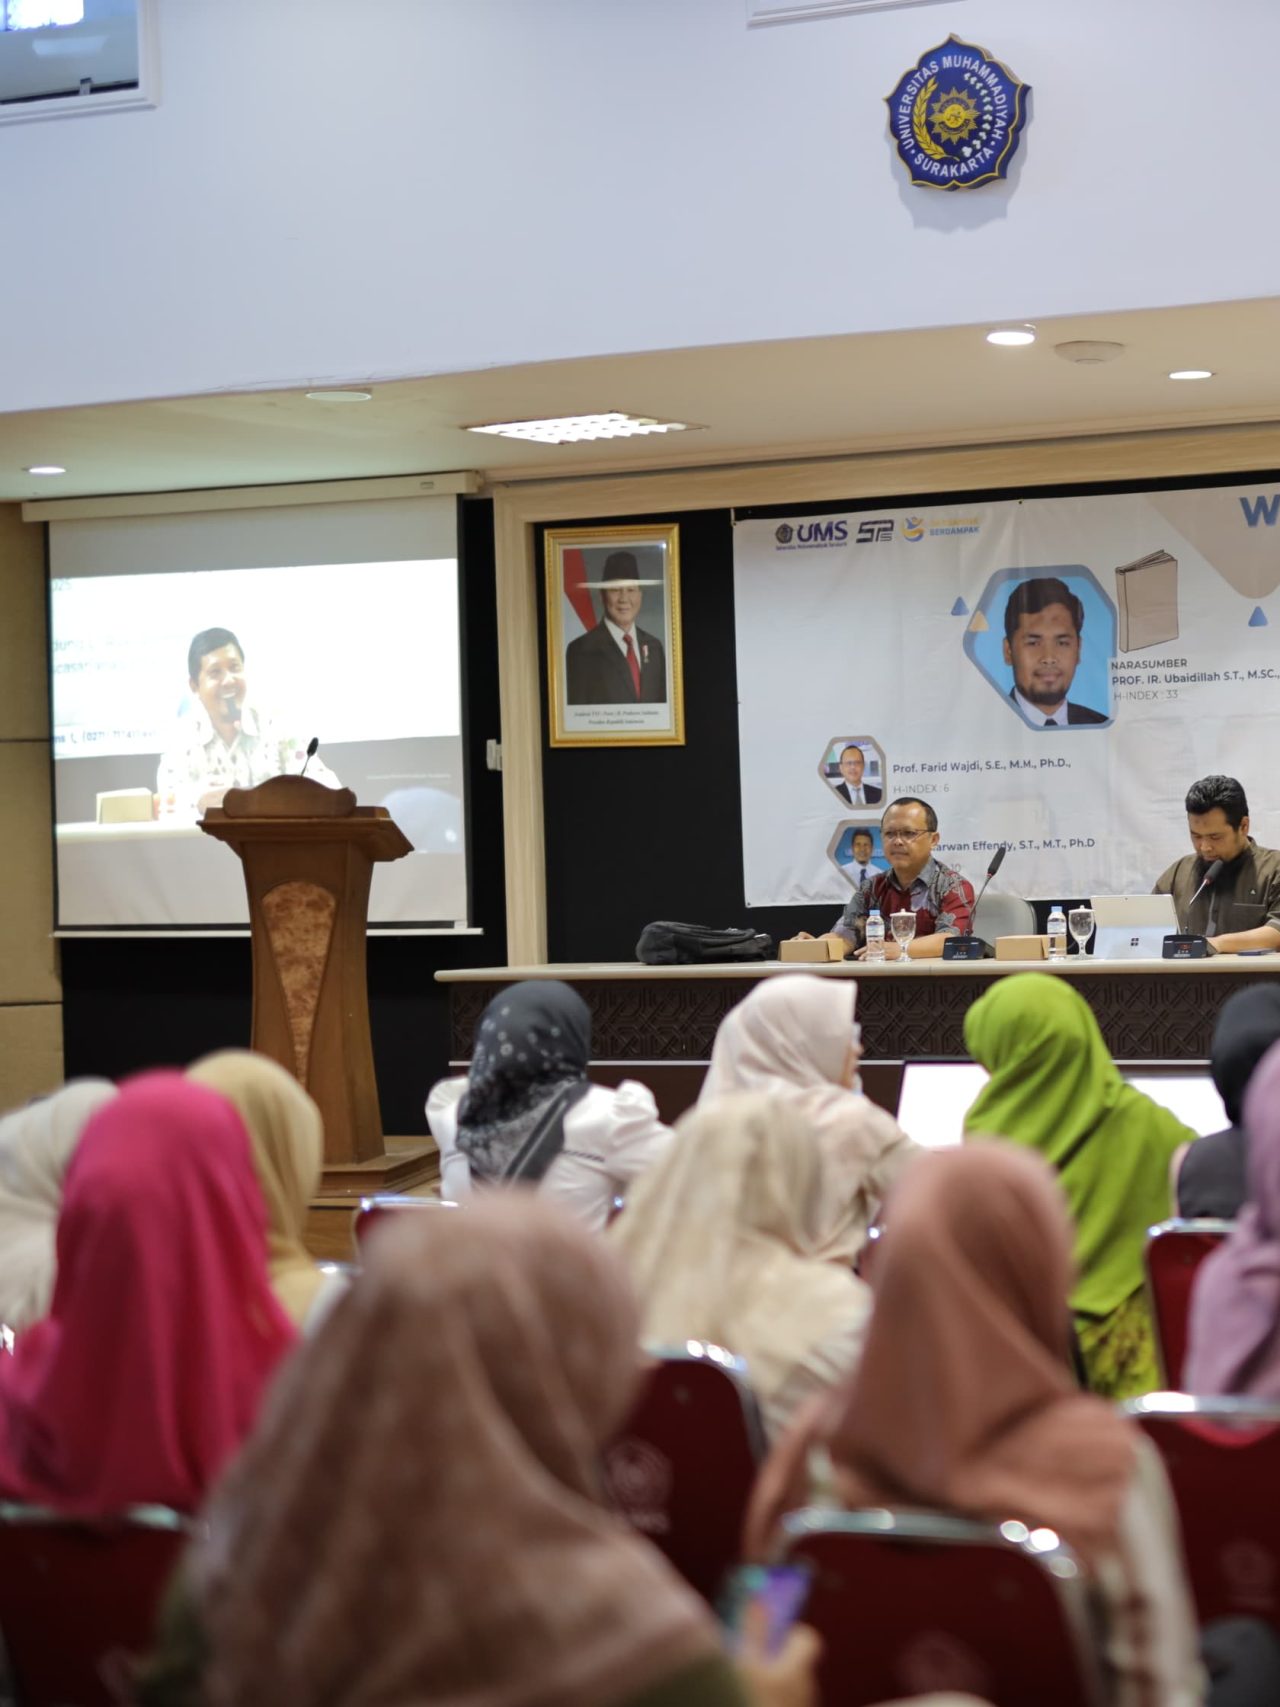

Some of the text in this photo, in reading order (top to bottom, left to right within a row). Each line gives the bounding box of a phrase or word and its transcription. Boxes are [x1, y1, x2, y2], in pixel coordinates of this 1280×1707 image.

[898, 55, 1009, 150] UNIVERSITAS MUHAMMADIYAH
[914, 146, 995, 177] SURAKARTA
[797, 520, 848, 542] UMS
[1111, 658, 1188, 670] NARASUMBER
[1112, 675, 1144, 685] PROF.
[1147, 674, 1161, 684] IR.
[1164, 672, 1220, 684] Ubaidillah
[1166, 689, 1179, 699] 33
[892, 763, 918, 774] Prof.
[921, 762, 948, 773] Farid
[950, 761, 983, 774] Wajdi,
[932, 842, 970, 852] arwan
[1069, 837, 1096, 848] Ph.D
